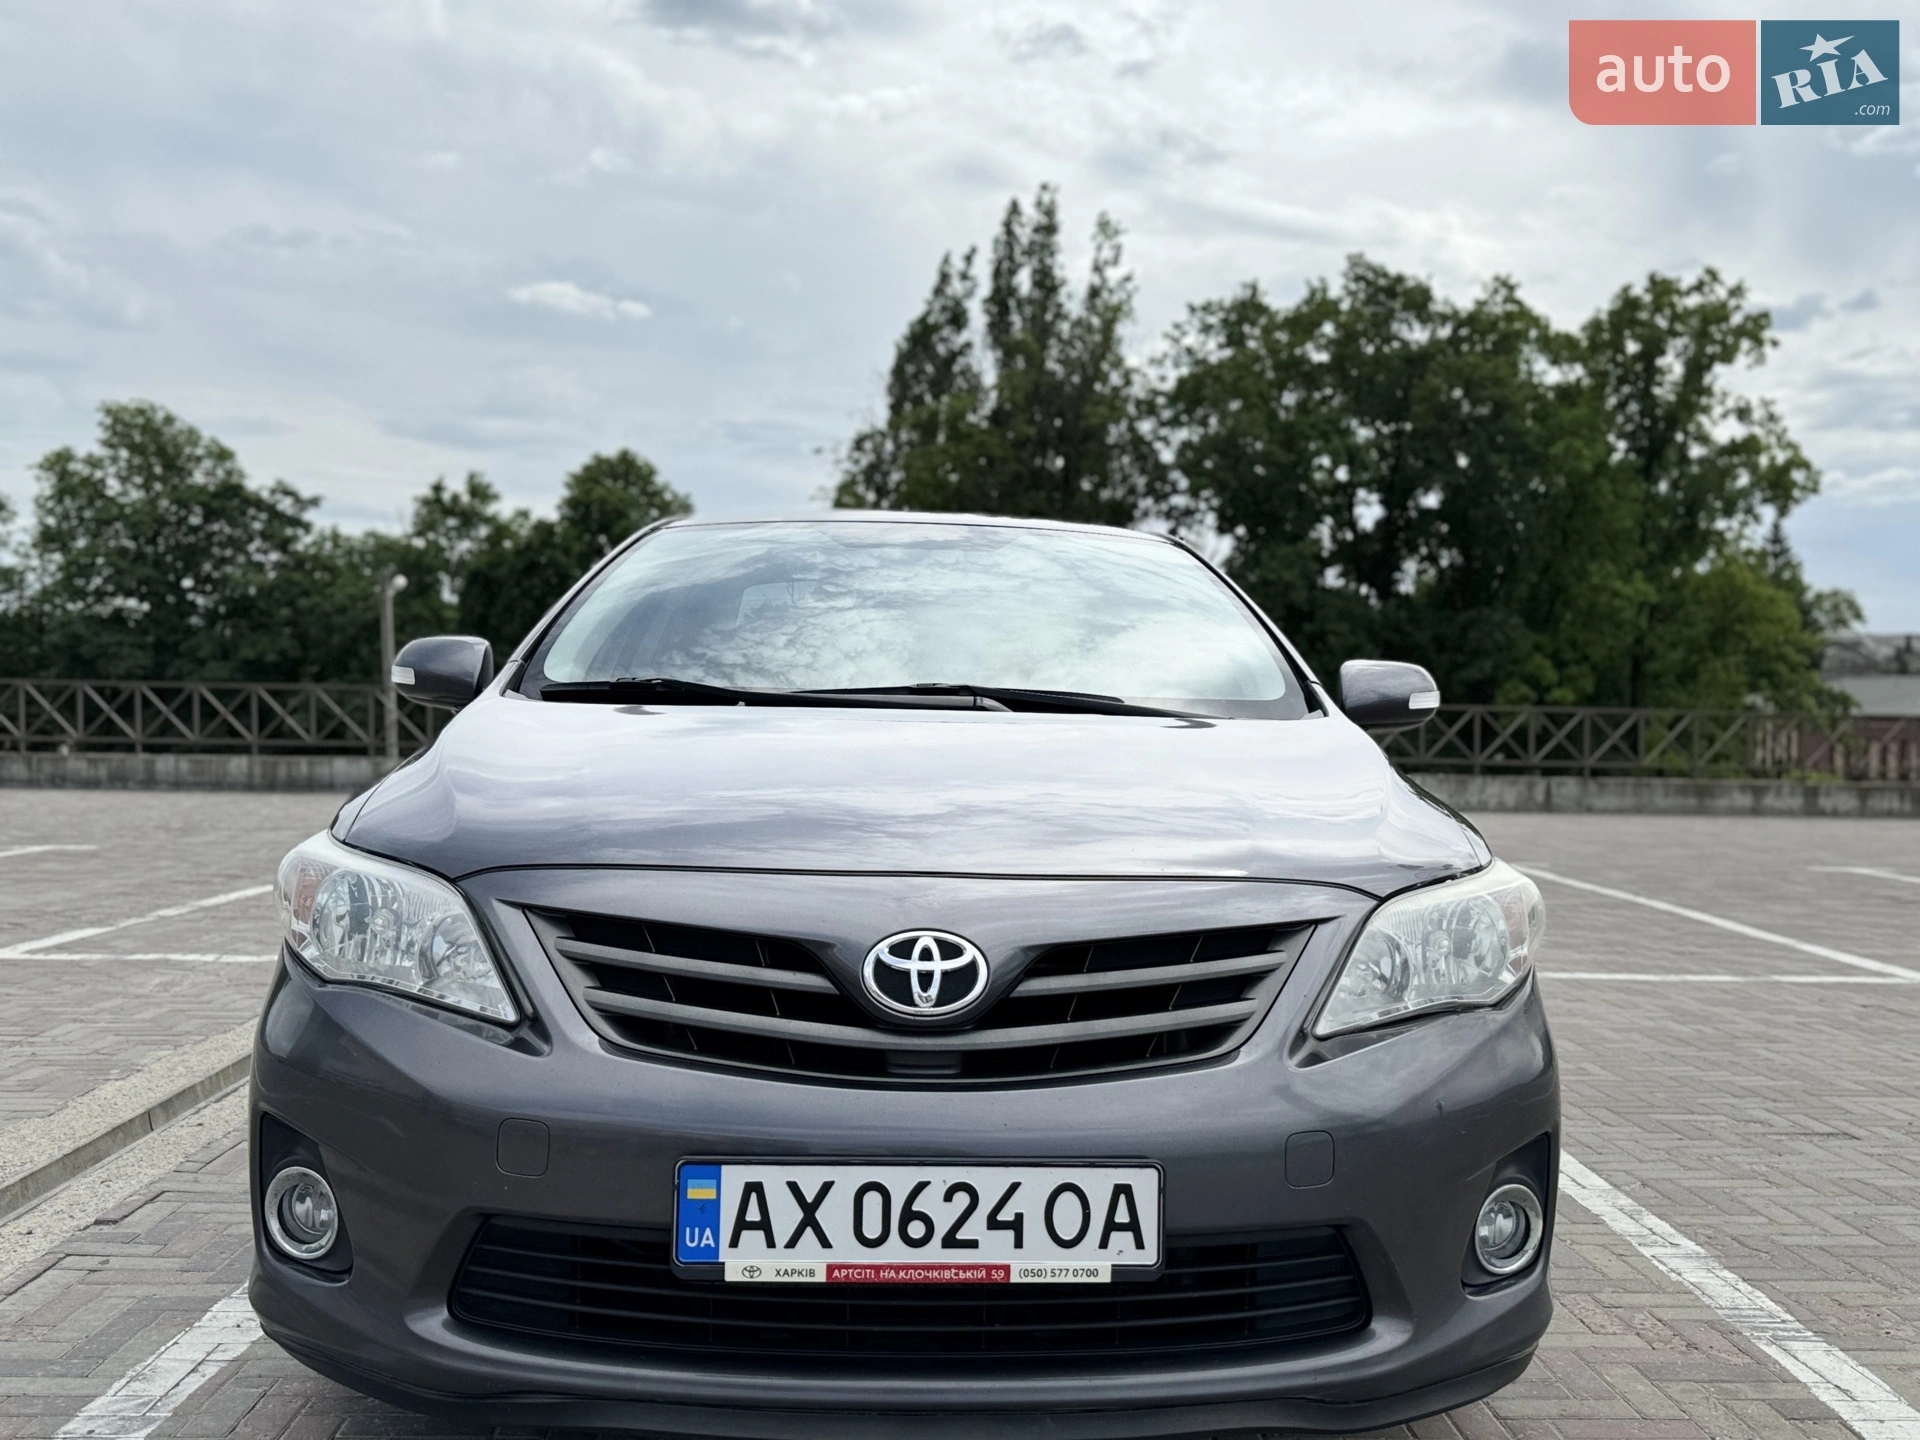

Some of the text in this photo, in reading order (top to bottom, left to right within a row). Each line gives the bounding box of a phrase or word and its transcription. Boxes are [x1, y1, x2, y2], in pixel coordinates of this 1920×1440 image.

[728, 1180, 1146, 1250] AX 0624 OA
[685, 1227, 716, 1248] UA
[774, 1268, 816, 1278] ХАРКІВ
[880, 1268, 896, 1279] НА
[899, 1267, 986, 1280] КЛОЧКІВСЬКІЙ
[990, 1270, 1005, 1280] 59
[1018, 1268, 1047, 1280] (050)
[1050, 1268, 1069, 1278] 577
[1072, 1268, 1099, 1278] 0700
